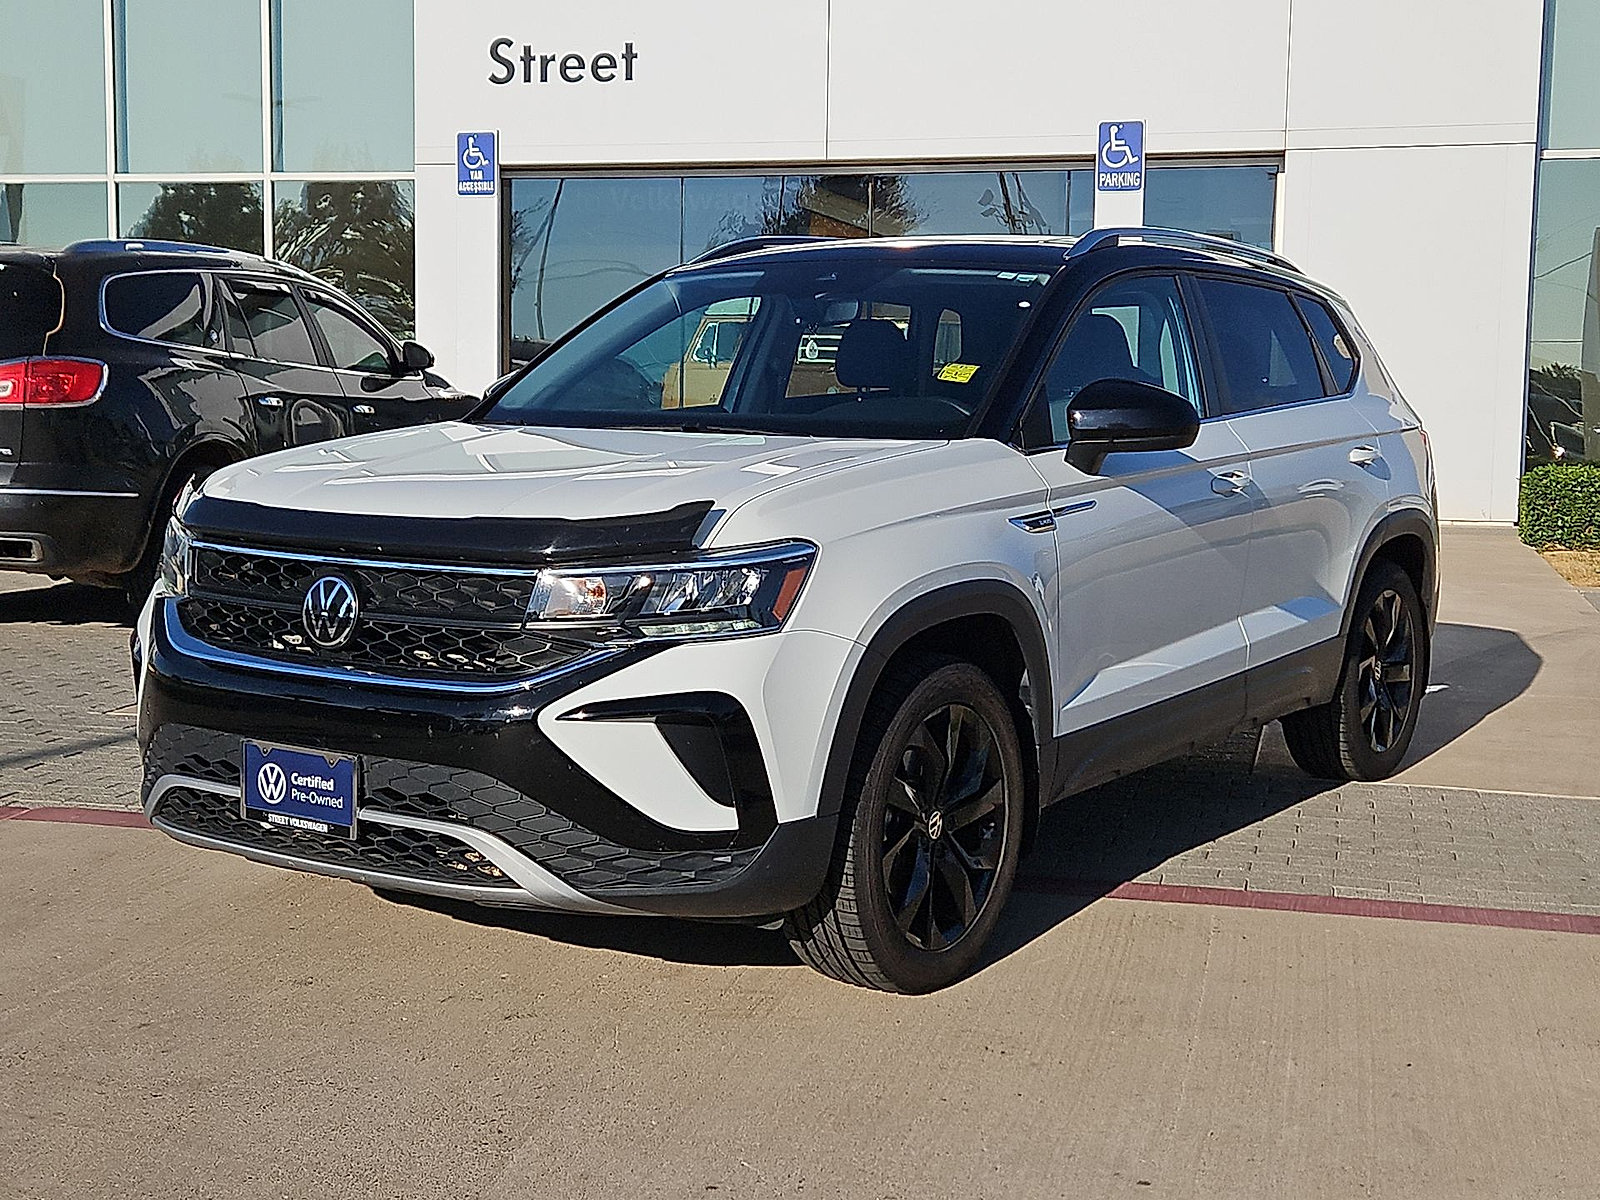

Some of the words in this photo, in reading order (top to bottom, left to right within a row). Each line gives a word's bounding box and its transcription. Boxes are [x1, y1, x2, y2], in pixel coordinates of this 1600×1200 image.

[488, 37, 638, 85] Street
[458, 181, 494, 192] ACCESSIBLE
[1099, 172, 1141, 188] PARKING
[291, 772, 334, 791] Certified
[291, 788, 344, 808] Pre-Owned
[267, 813, 290, 826] STREET
[289, 817, 329, 833] VOLKSWAGEN
